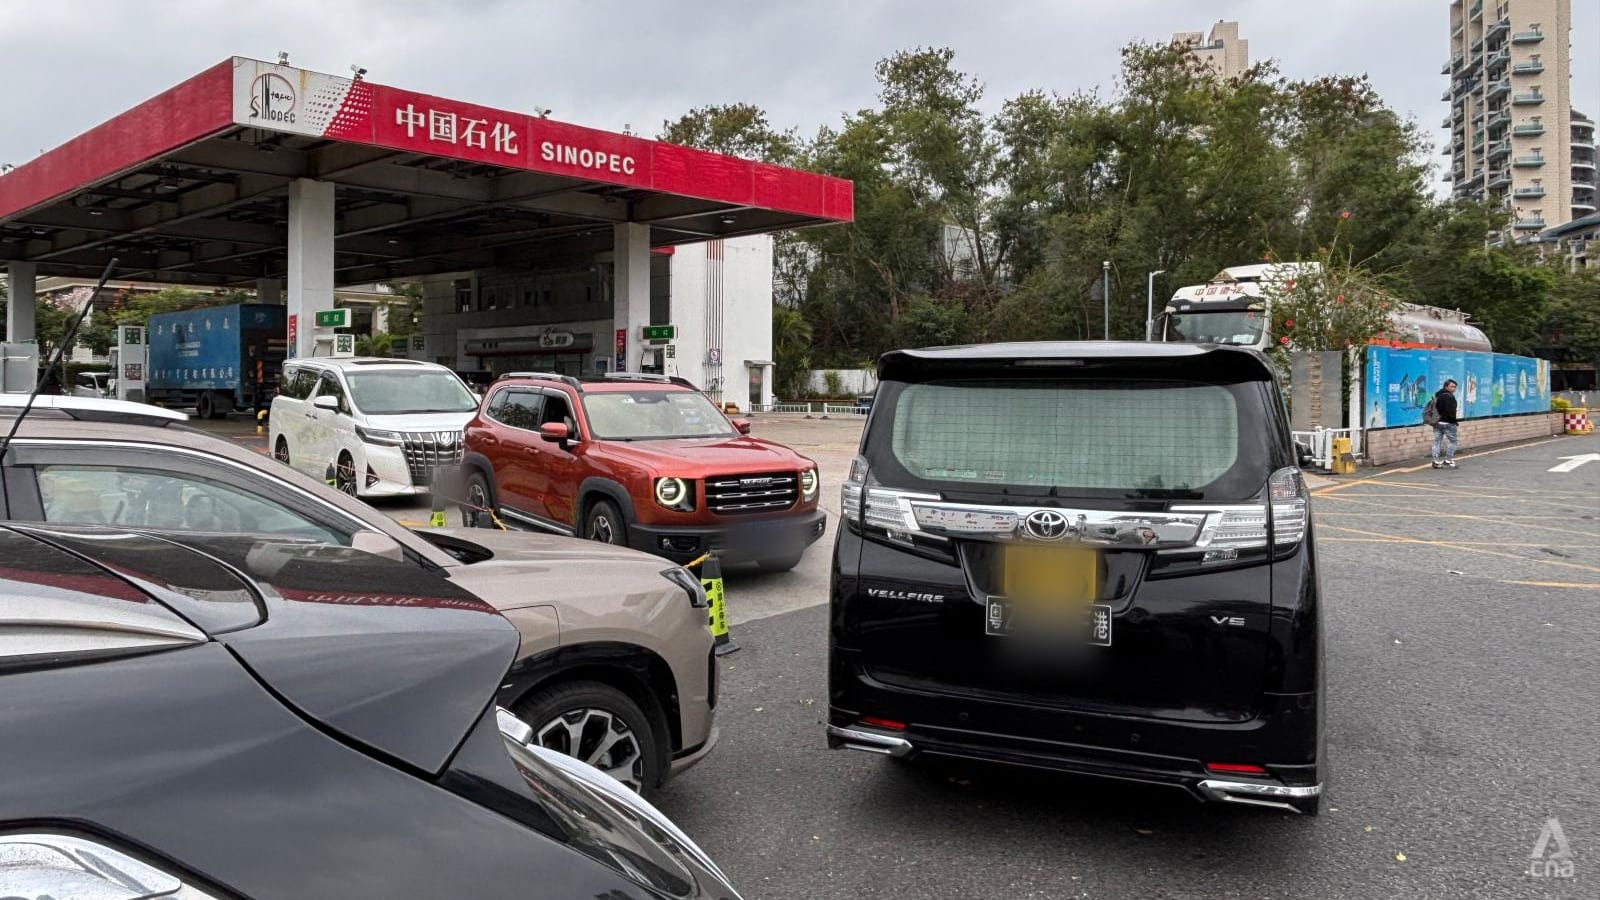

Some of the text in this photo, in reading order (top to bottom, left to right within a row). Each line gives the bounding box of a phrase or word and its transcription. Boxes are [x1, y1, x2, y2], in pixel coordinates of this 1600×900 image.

[396, 103, 519, 155] 中国石化
[540, 141, 636, 175] SINOPEC
[867, 588, 944, 603] VELLFIRE
